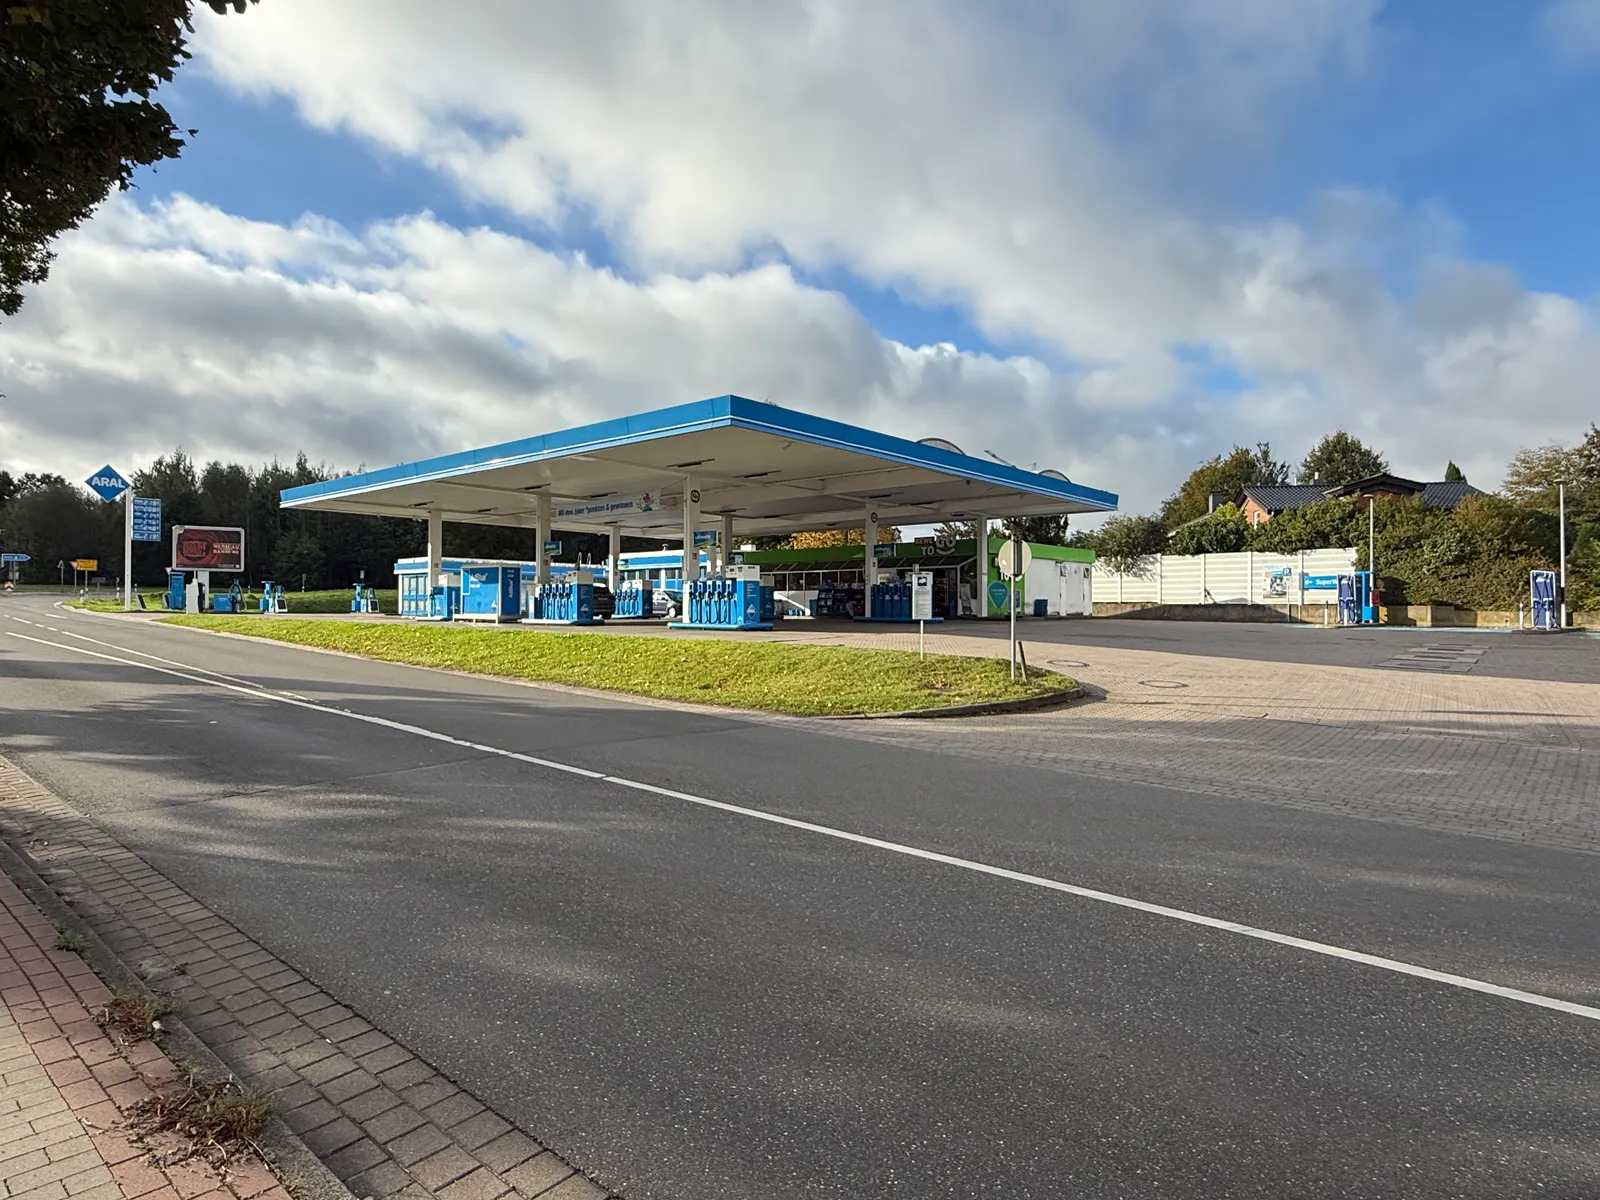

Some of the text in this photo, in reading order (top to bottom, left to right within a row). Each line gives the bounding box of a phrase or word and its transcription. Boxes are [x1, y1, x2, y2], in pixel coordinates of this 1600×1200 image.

[91, 476, 125, 488] ARAL
[610, 501, 633, 511] gewinnen
[915, 537, 935, 545] REWE
[921, 535, 956, 556] TO GO
